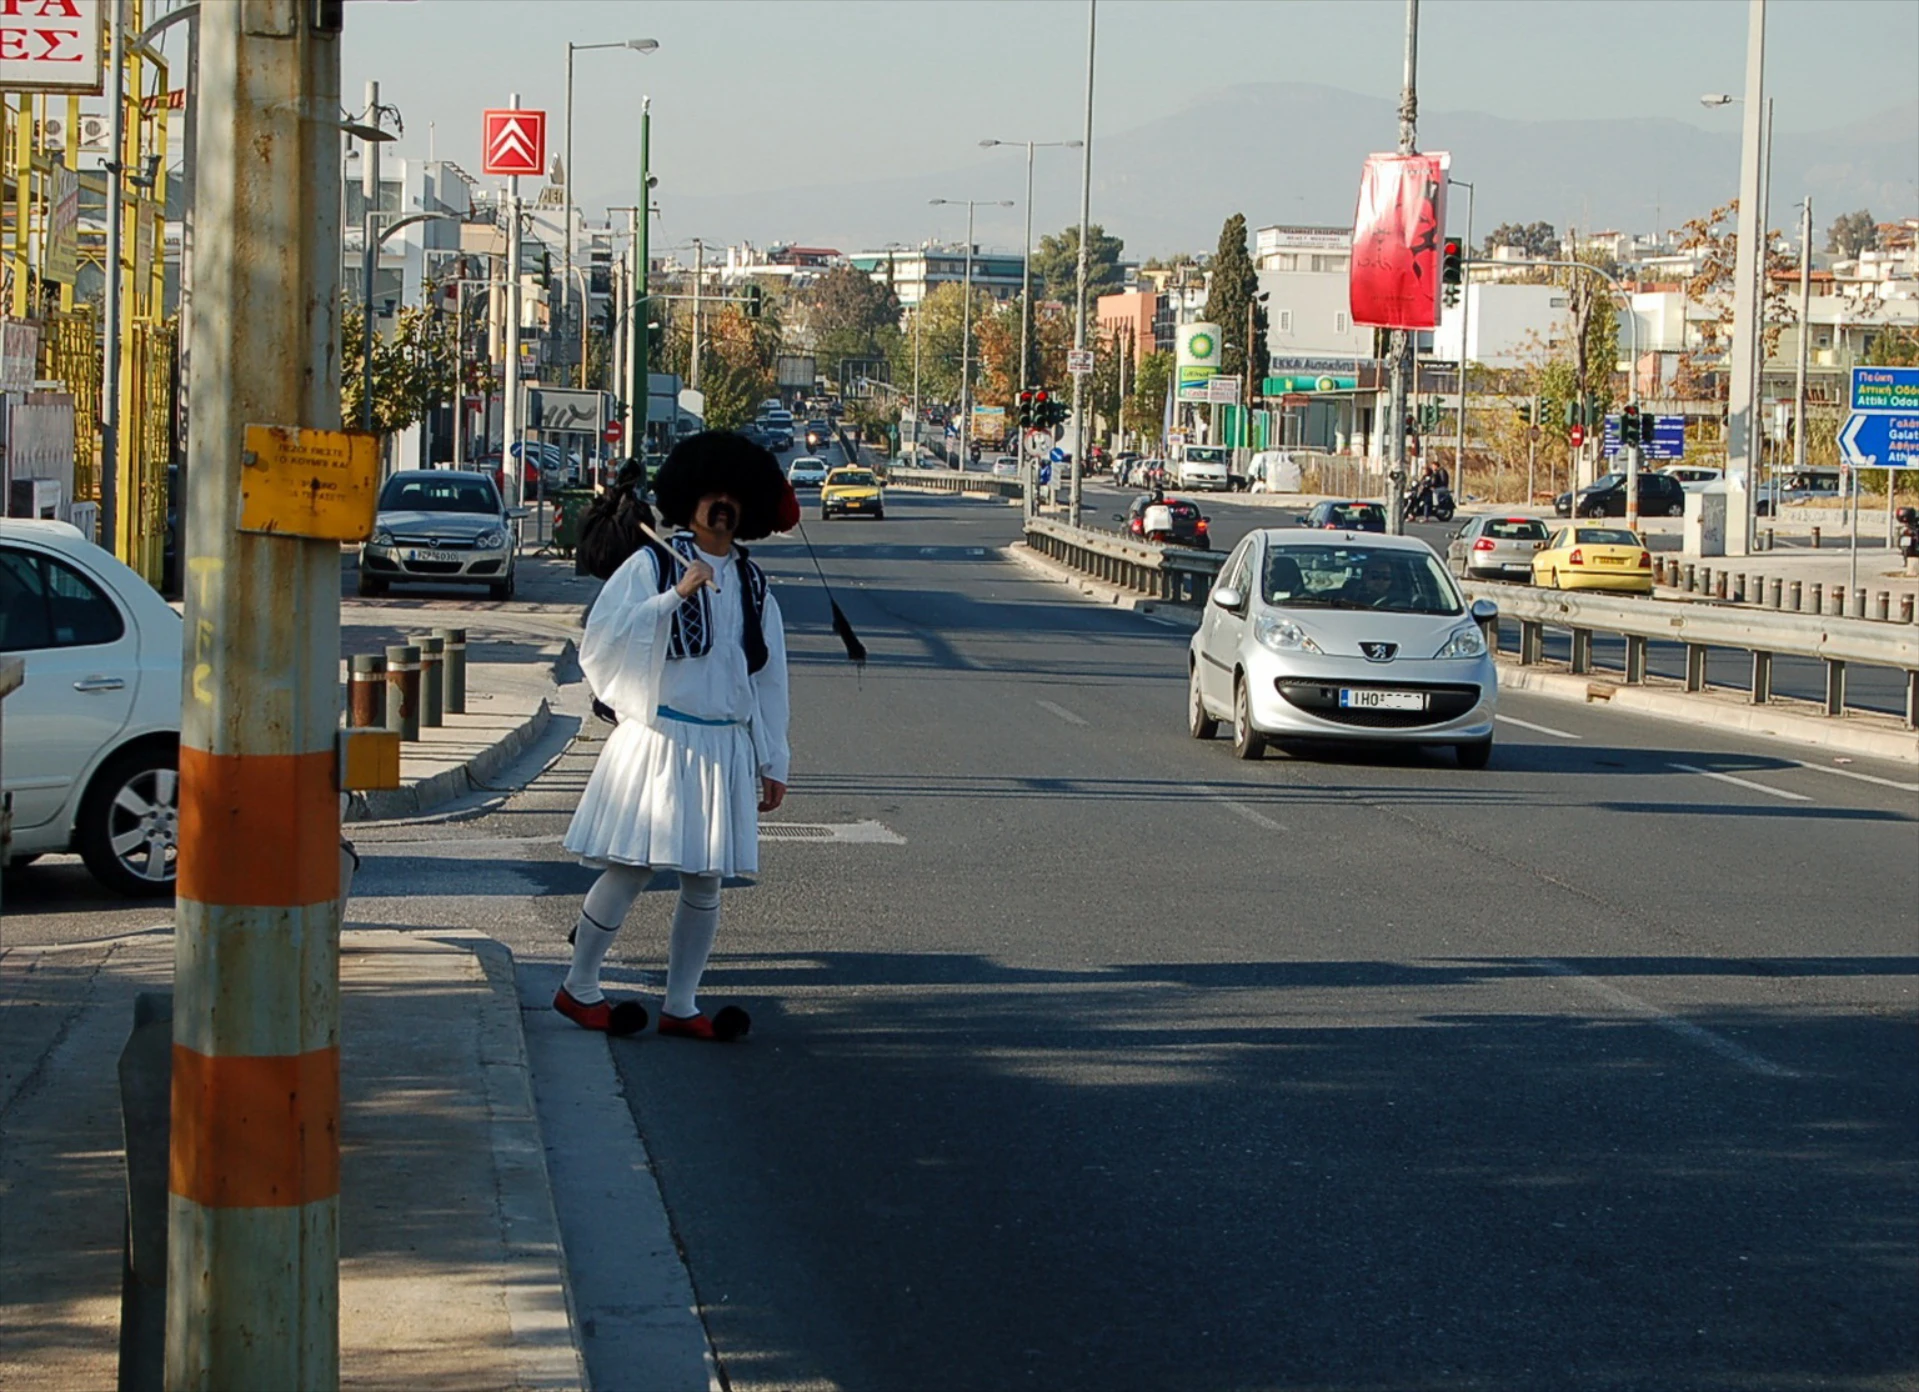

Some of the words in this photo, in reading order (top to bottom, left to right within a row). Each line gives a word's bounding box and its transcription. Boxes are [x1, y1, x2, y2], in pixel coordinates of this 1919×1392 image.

[0, 28, 83, 62] ΕΣ
[1859, 372, 1893, 384] Πεύκη
[1858, 385, 1892, 396] Αττική
[1857, 396, 1887, 405] Attiki
[1890, 396, 1919, 407] Odos
